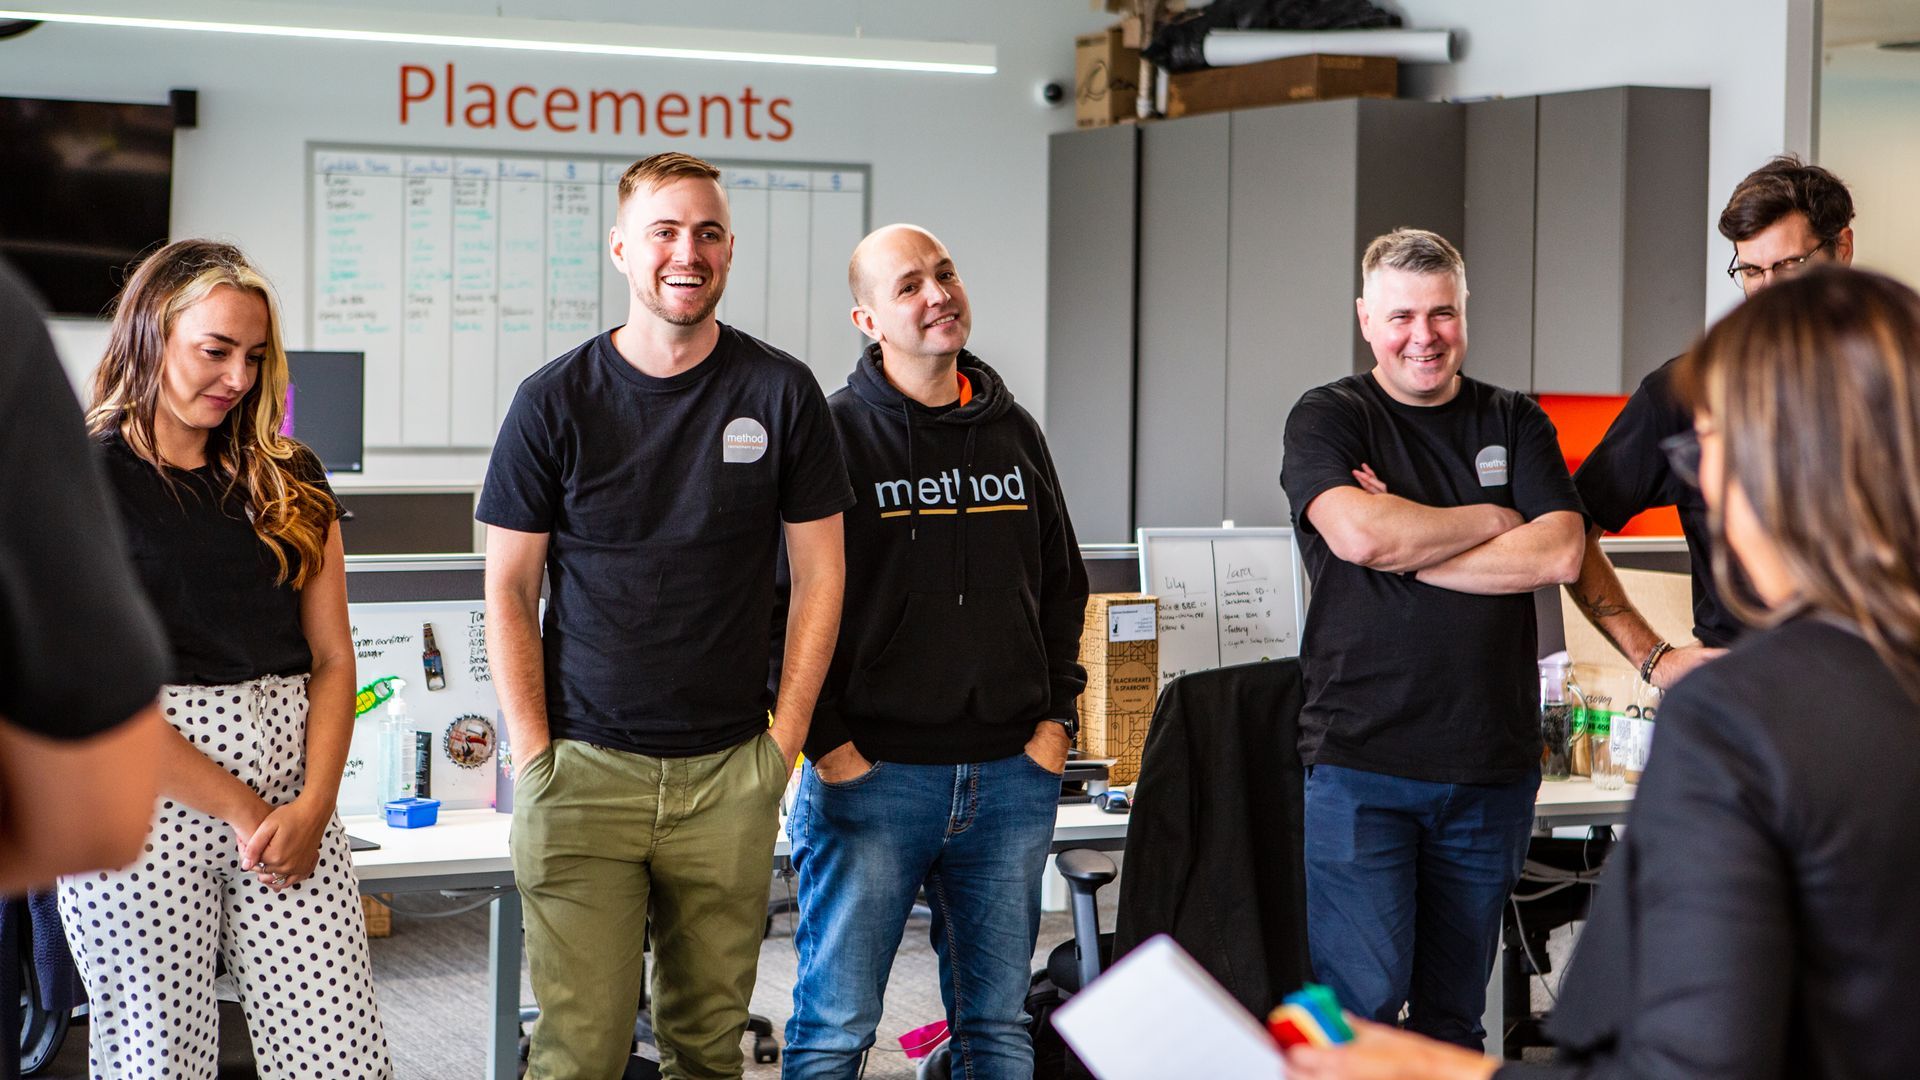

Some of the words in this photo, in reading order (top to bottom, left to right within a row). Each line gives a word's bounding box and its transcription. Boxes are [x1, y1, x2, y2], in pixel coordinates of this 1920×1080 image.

[398, 62, 794, 142] Placements
[727, 433, 763, 443] method
[1479, 458, 1507, 469] metho
[875, 465, 1026, 508] method
